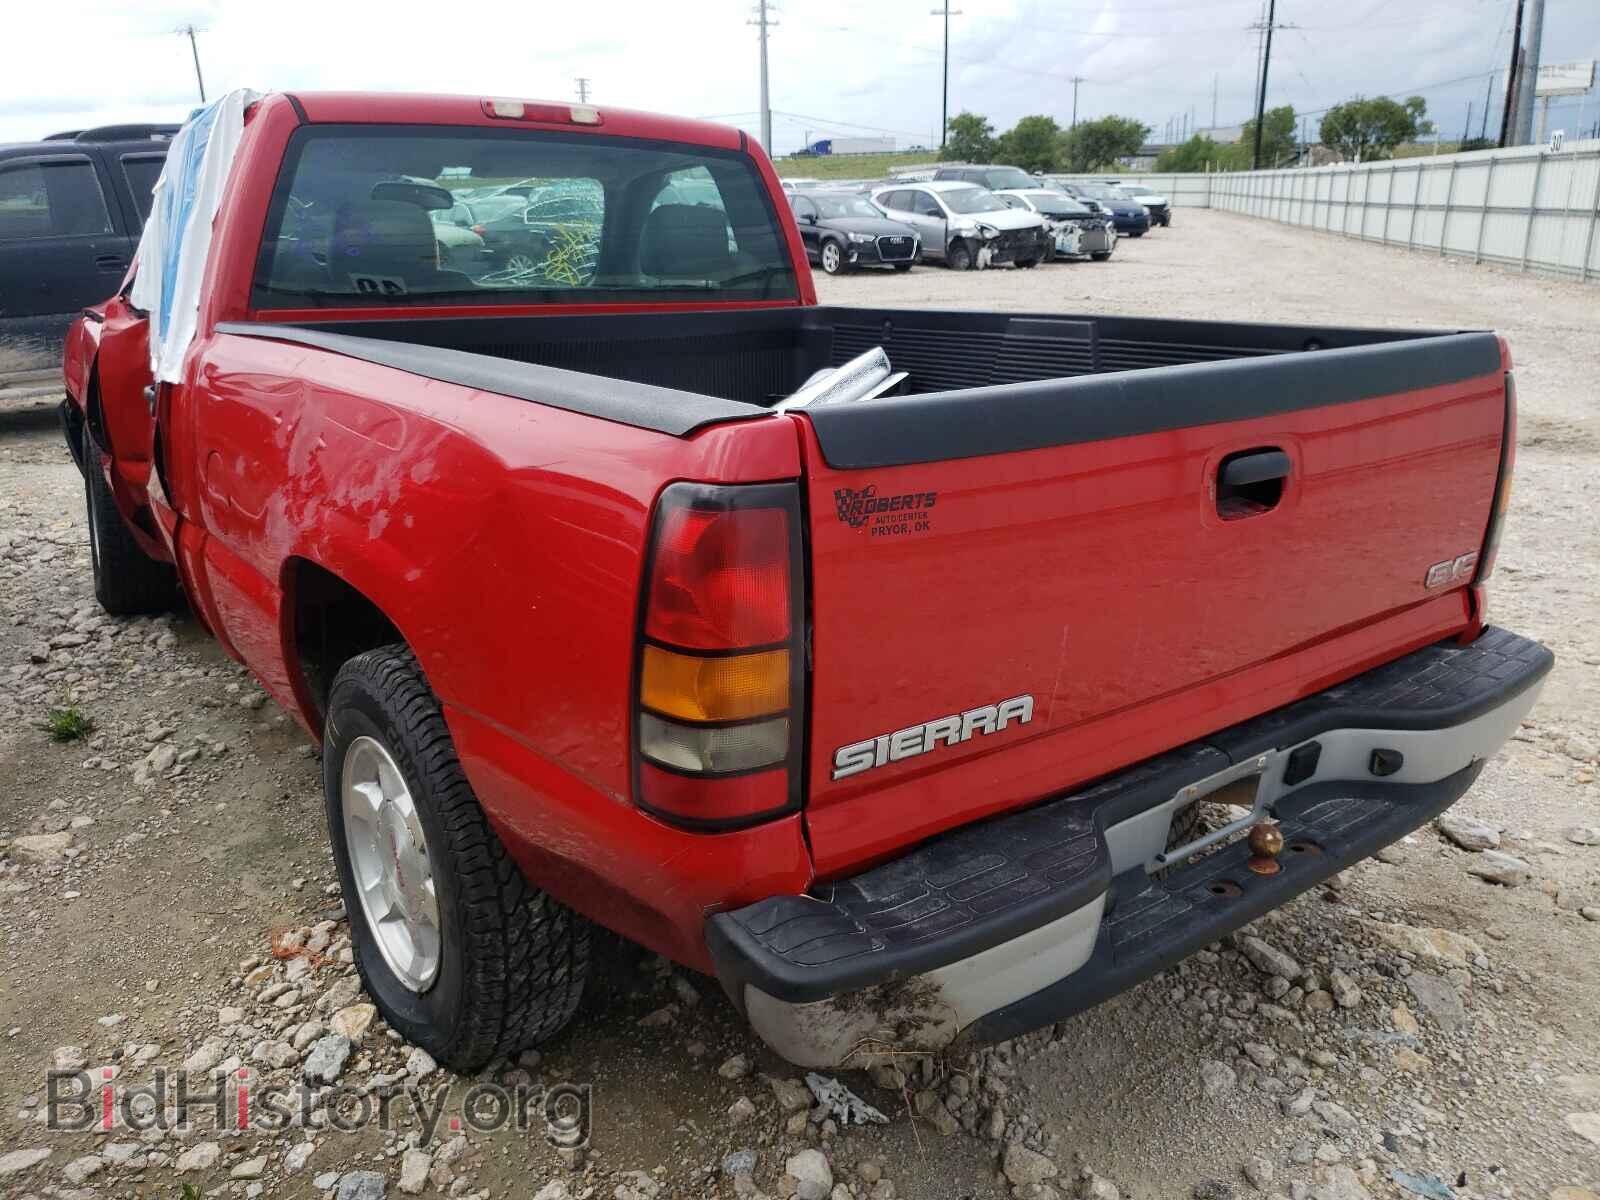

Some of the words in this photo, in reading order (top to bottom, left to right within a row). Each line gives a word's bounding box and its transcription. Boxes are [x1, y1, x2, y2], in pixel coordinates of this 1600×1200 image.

[849, 492, 937, 515] ROBERTS
[876, 515, 897, 524] AUTO
[898, 511, 928, 522] CENTER
[871, 523, 912, 536] PRYOR,
[914, 521, 930, 532] OK
[832, 694, 1034, 780] SIERRA
